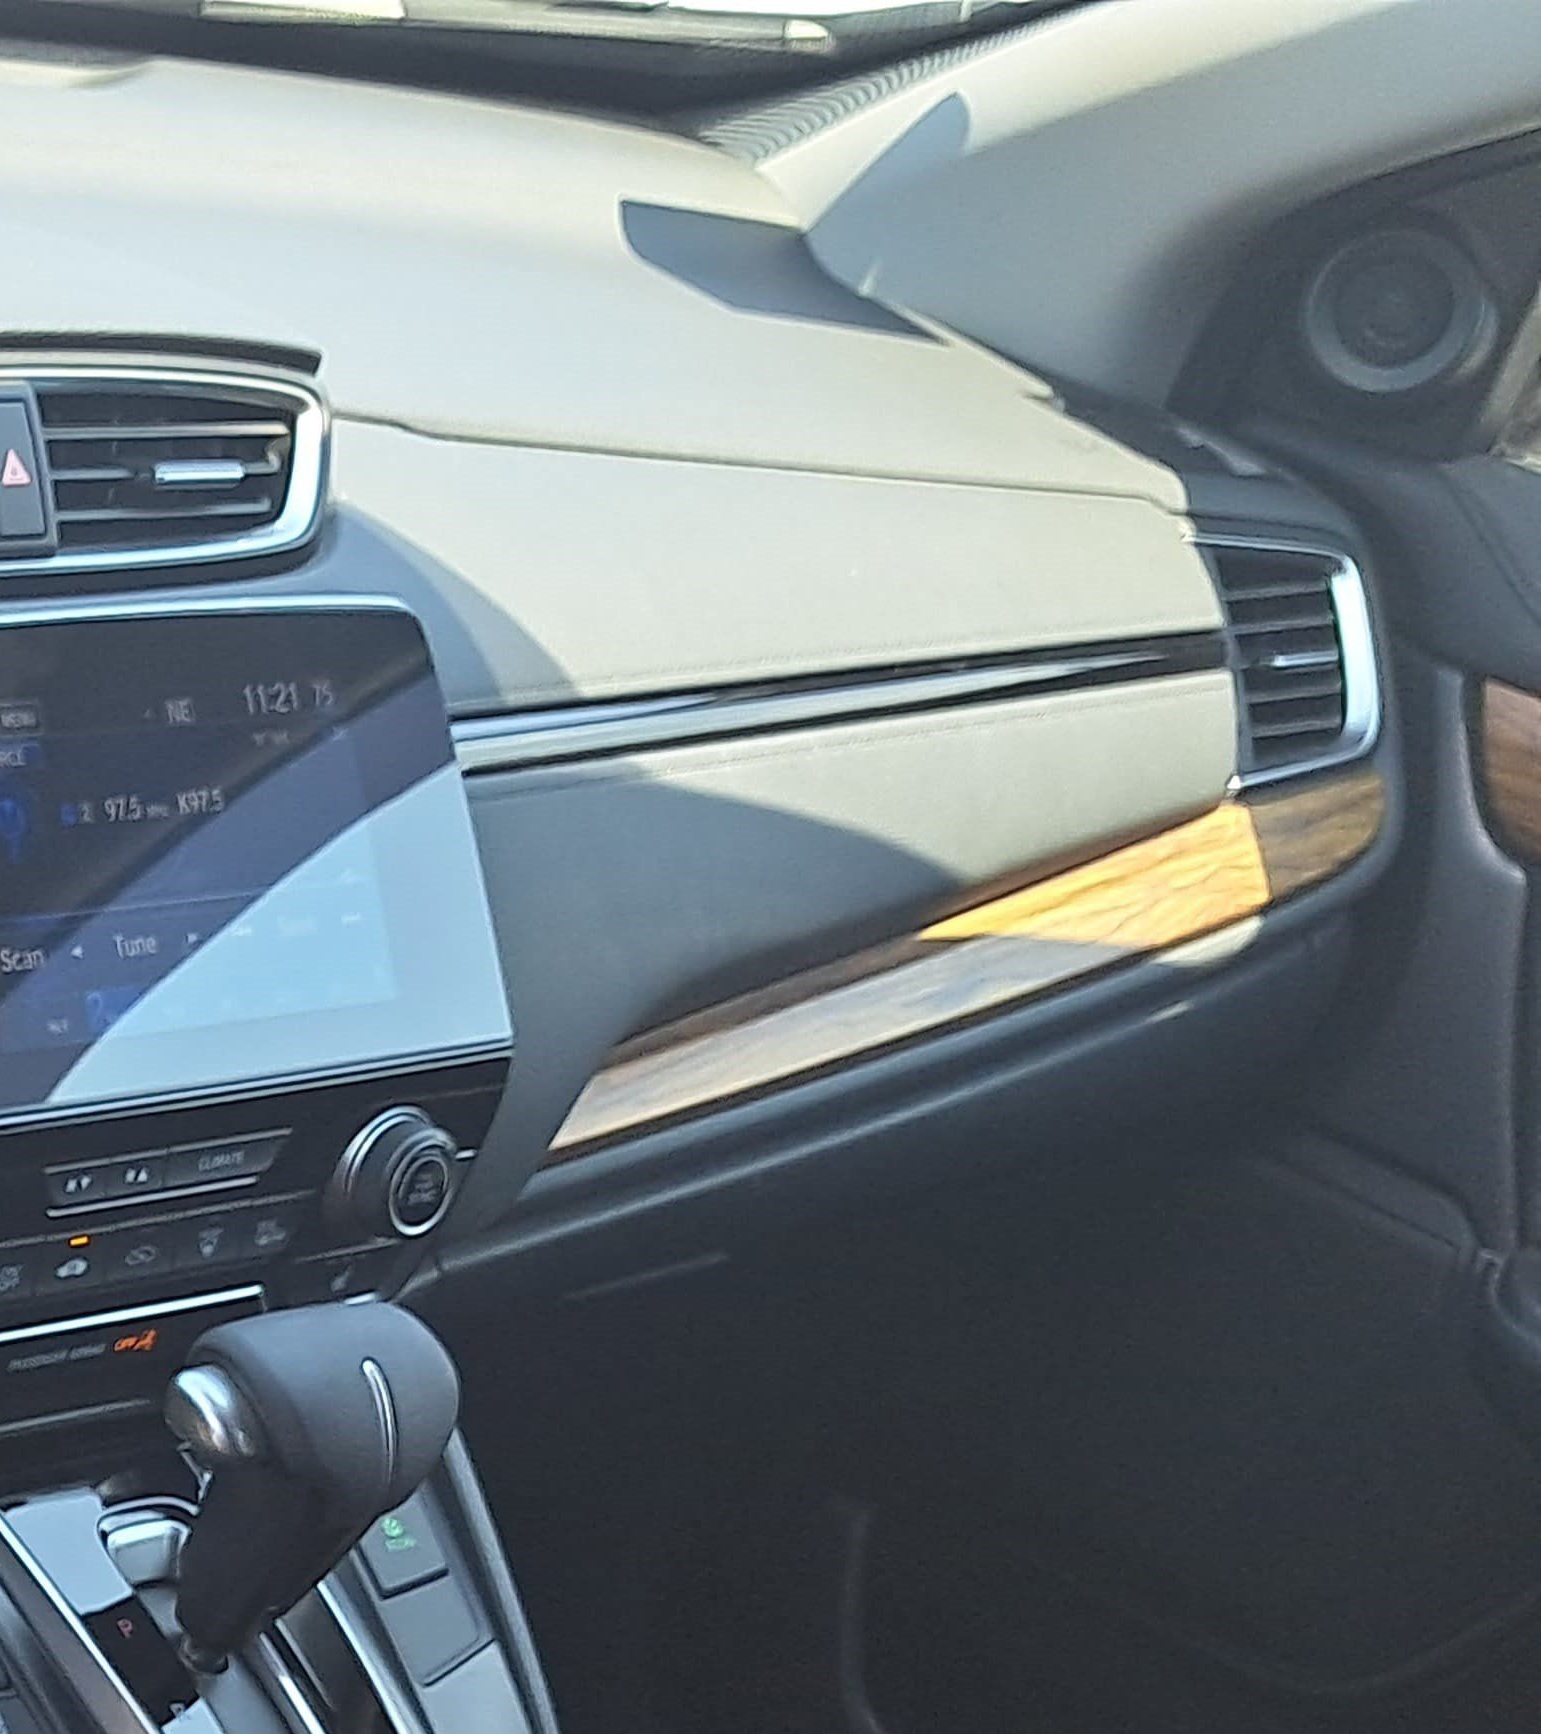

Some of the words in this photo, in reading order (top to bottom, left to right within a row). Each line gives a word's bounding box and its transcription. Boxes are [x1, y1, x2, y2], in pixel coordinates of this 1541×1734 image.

[243, 676, 299, 715] 11:21
[0, 945, 45, 973] Scan
[112, 931, 158, 959] Tune
